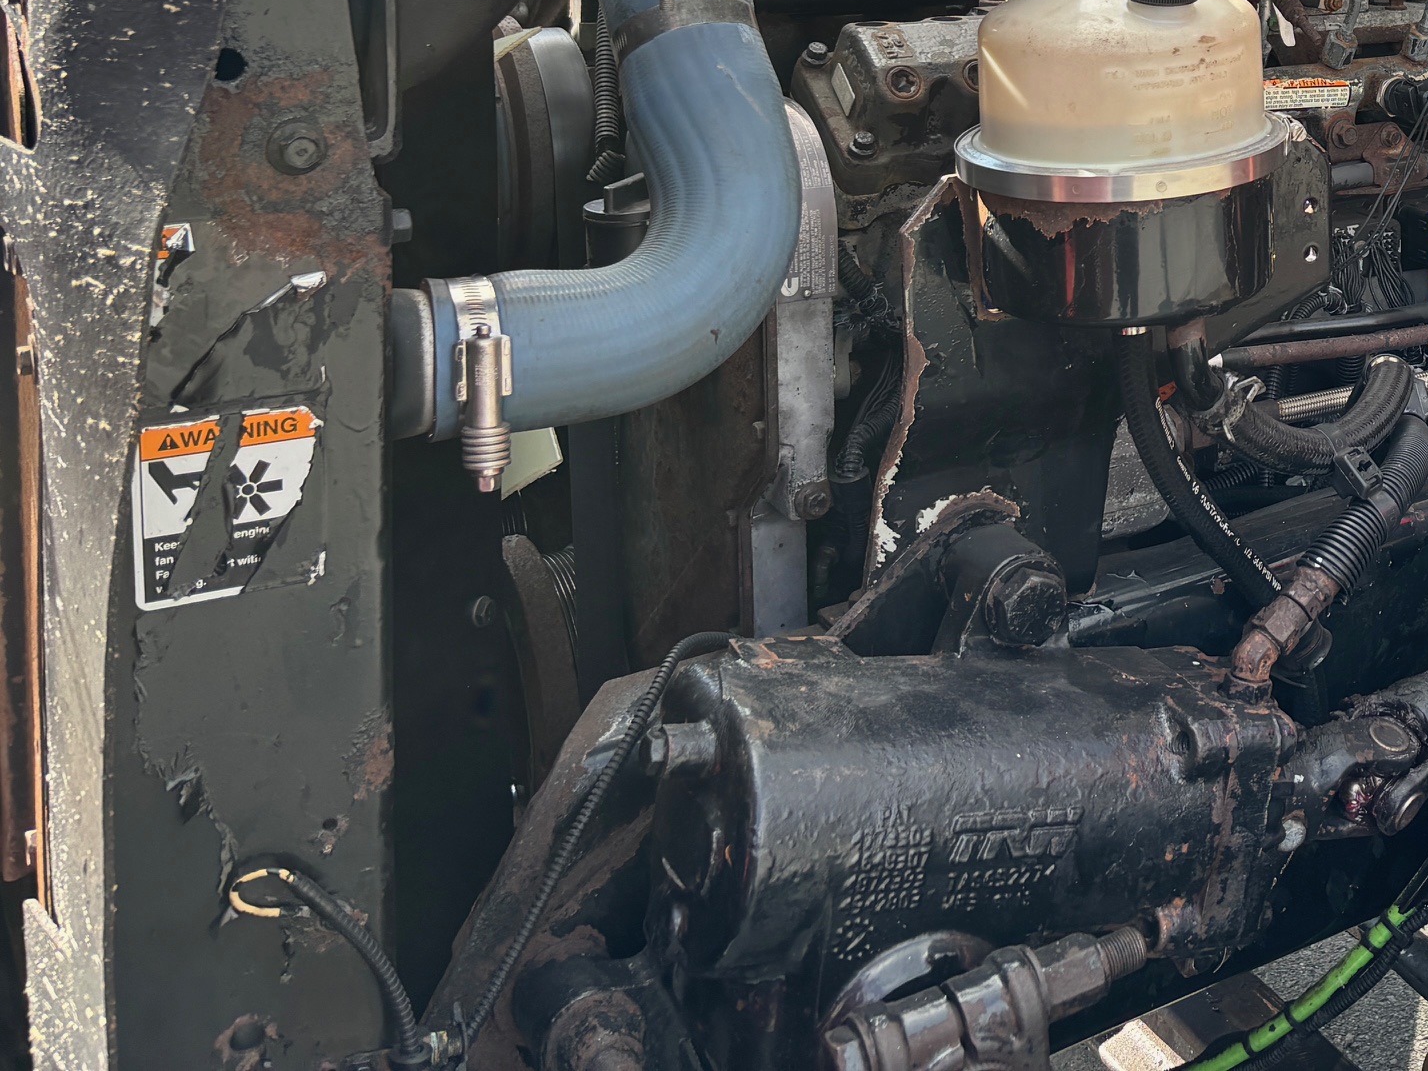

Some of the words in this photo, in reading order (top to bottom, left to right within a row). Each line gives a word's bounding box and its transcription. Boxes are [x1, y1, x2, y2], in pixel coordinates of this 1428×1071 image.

[180, 417, 299, 448] WANING
[233, 526, 270, 539] engin
[155, 541, 180, 552] Kee
[155, 556, 174, 566] fan
[237, 553, 262, 566] wit
[155, 570, 170, 580] Fa
[949, 806, 1084, 863] TRW
